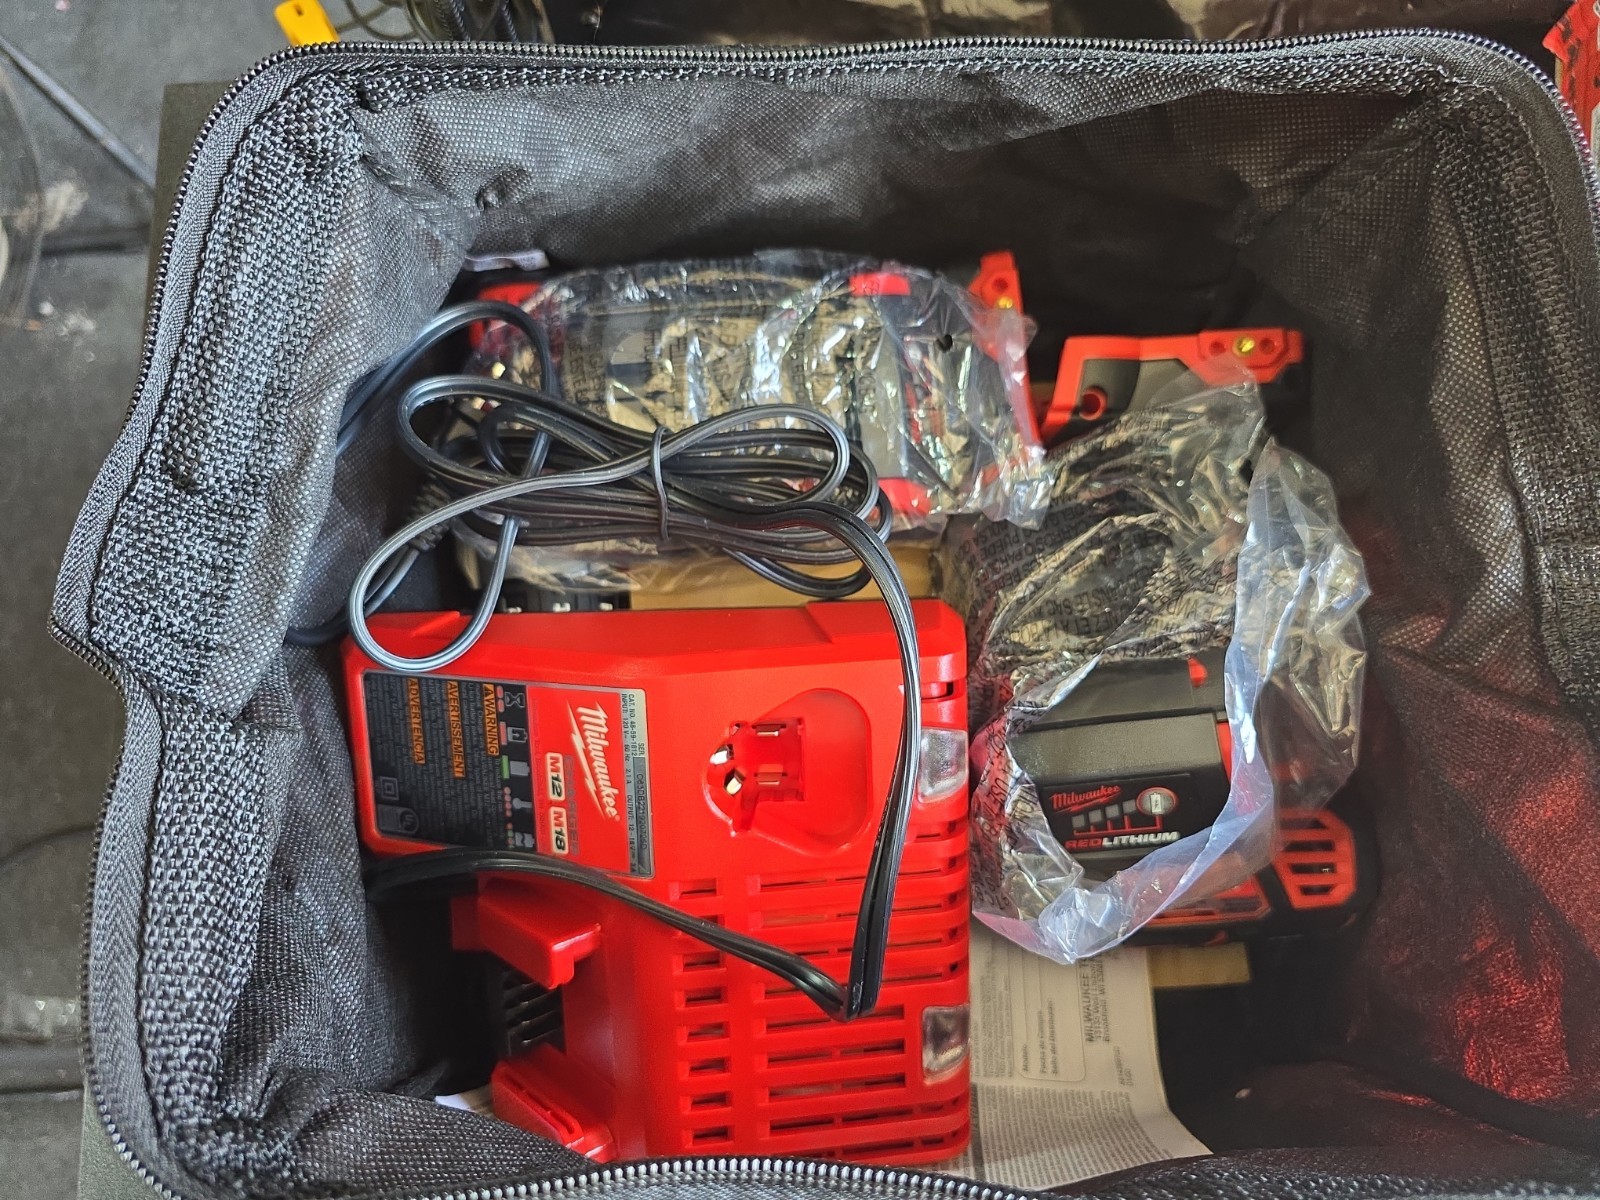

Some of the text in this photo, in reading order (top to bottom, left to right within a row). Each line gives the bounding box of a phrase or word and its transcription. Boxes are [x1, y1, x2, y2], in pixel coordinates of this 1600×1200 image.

[409, 679, 424, 761] ADVERTENCIA
[449, 683, 463, 775] AVERTISSEMENT
[485, 698, 498, 754] WARNING
[576, 702, 619, 818] Milwaukee
[550, 756, 566, 850] M12 M18
[1049, 784, 1122, 810] Milwaukee
[1081, 972, 1094, 1042] MILWAUKEE
